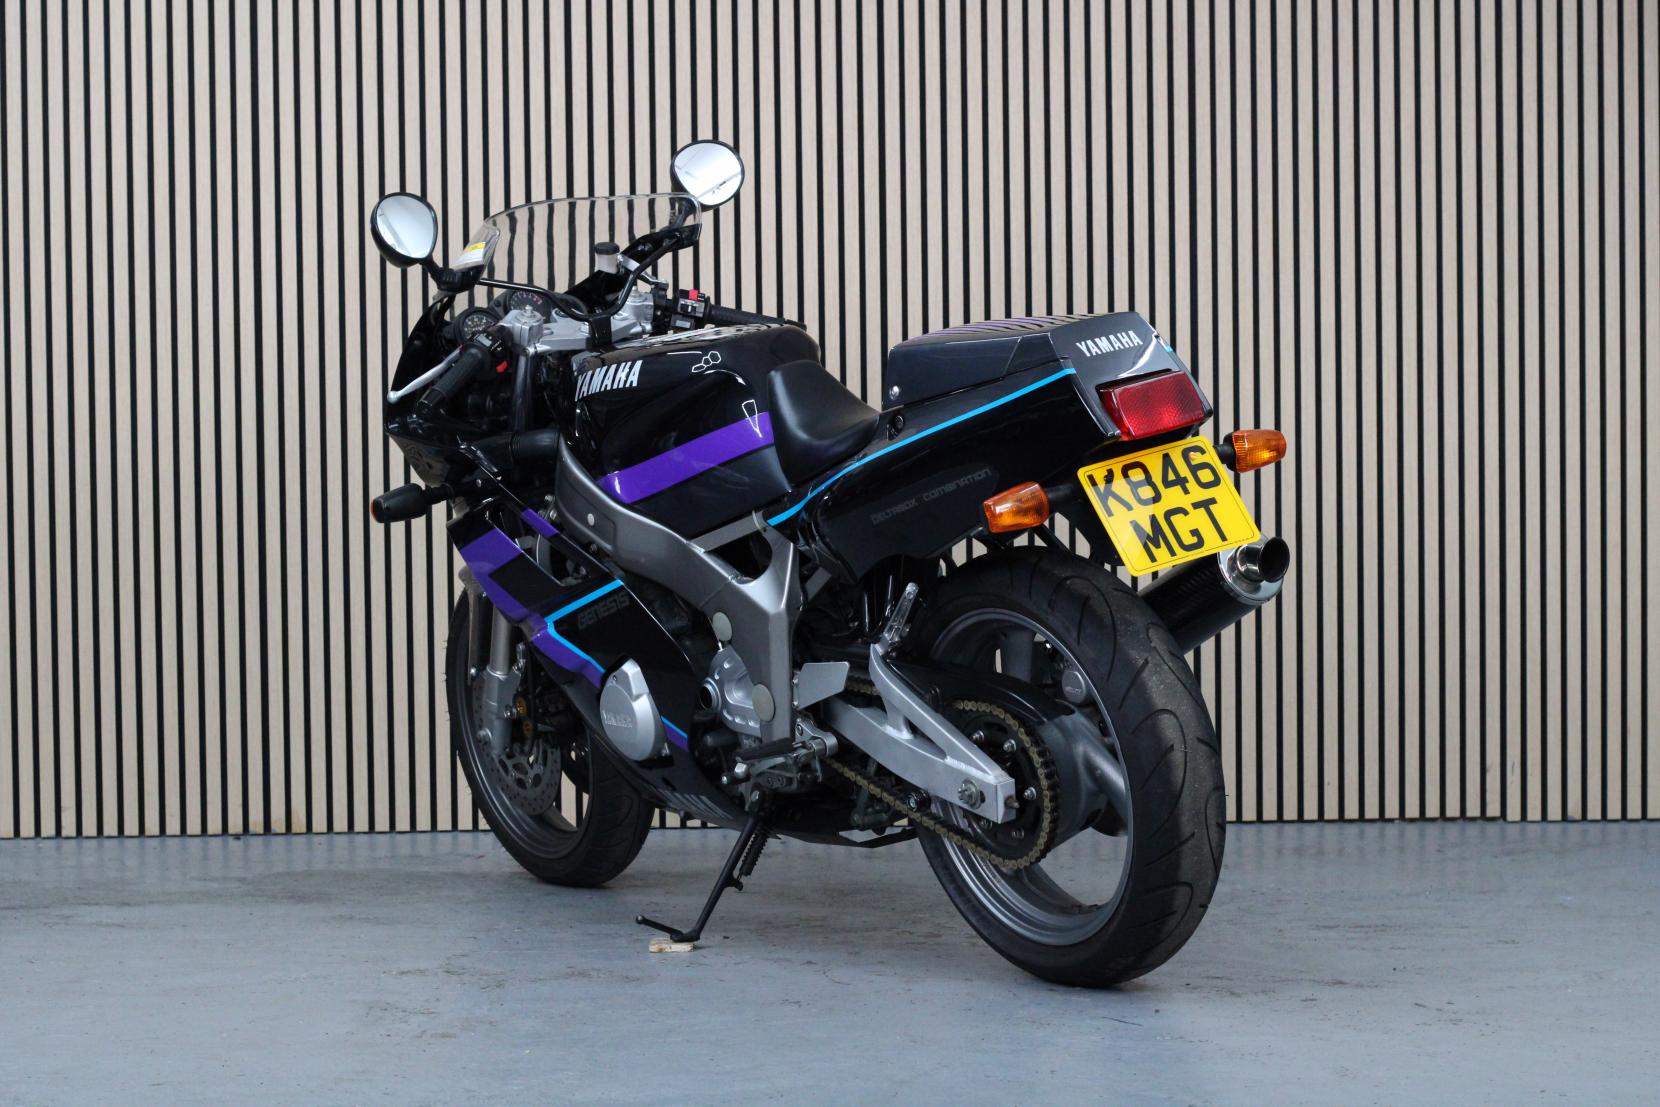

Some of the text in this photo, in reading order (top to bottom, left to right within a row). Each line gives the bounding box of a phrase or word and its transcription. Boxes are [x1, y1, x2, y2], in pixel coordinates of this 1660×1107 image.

[1075, 330, 1144, 357] YAMAHA
[574, 360, 643, 402] YAMAHA
[1087, 445, 1221, 517] K846
[1130, 497, 1227, 563] MGT
